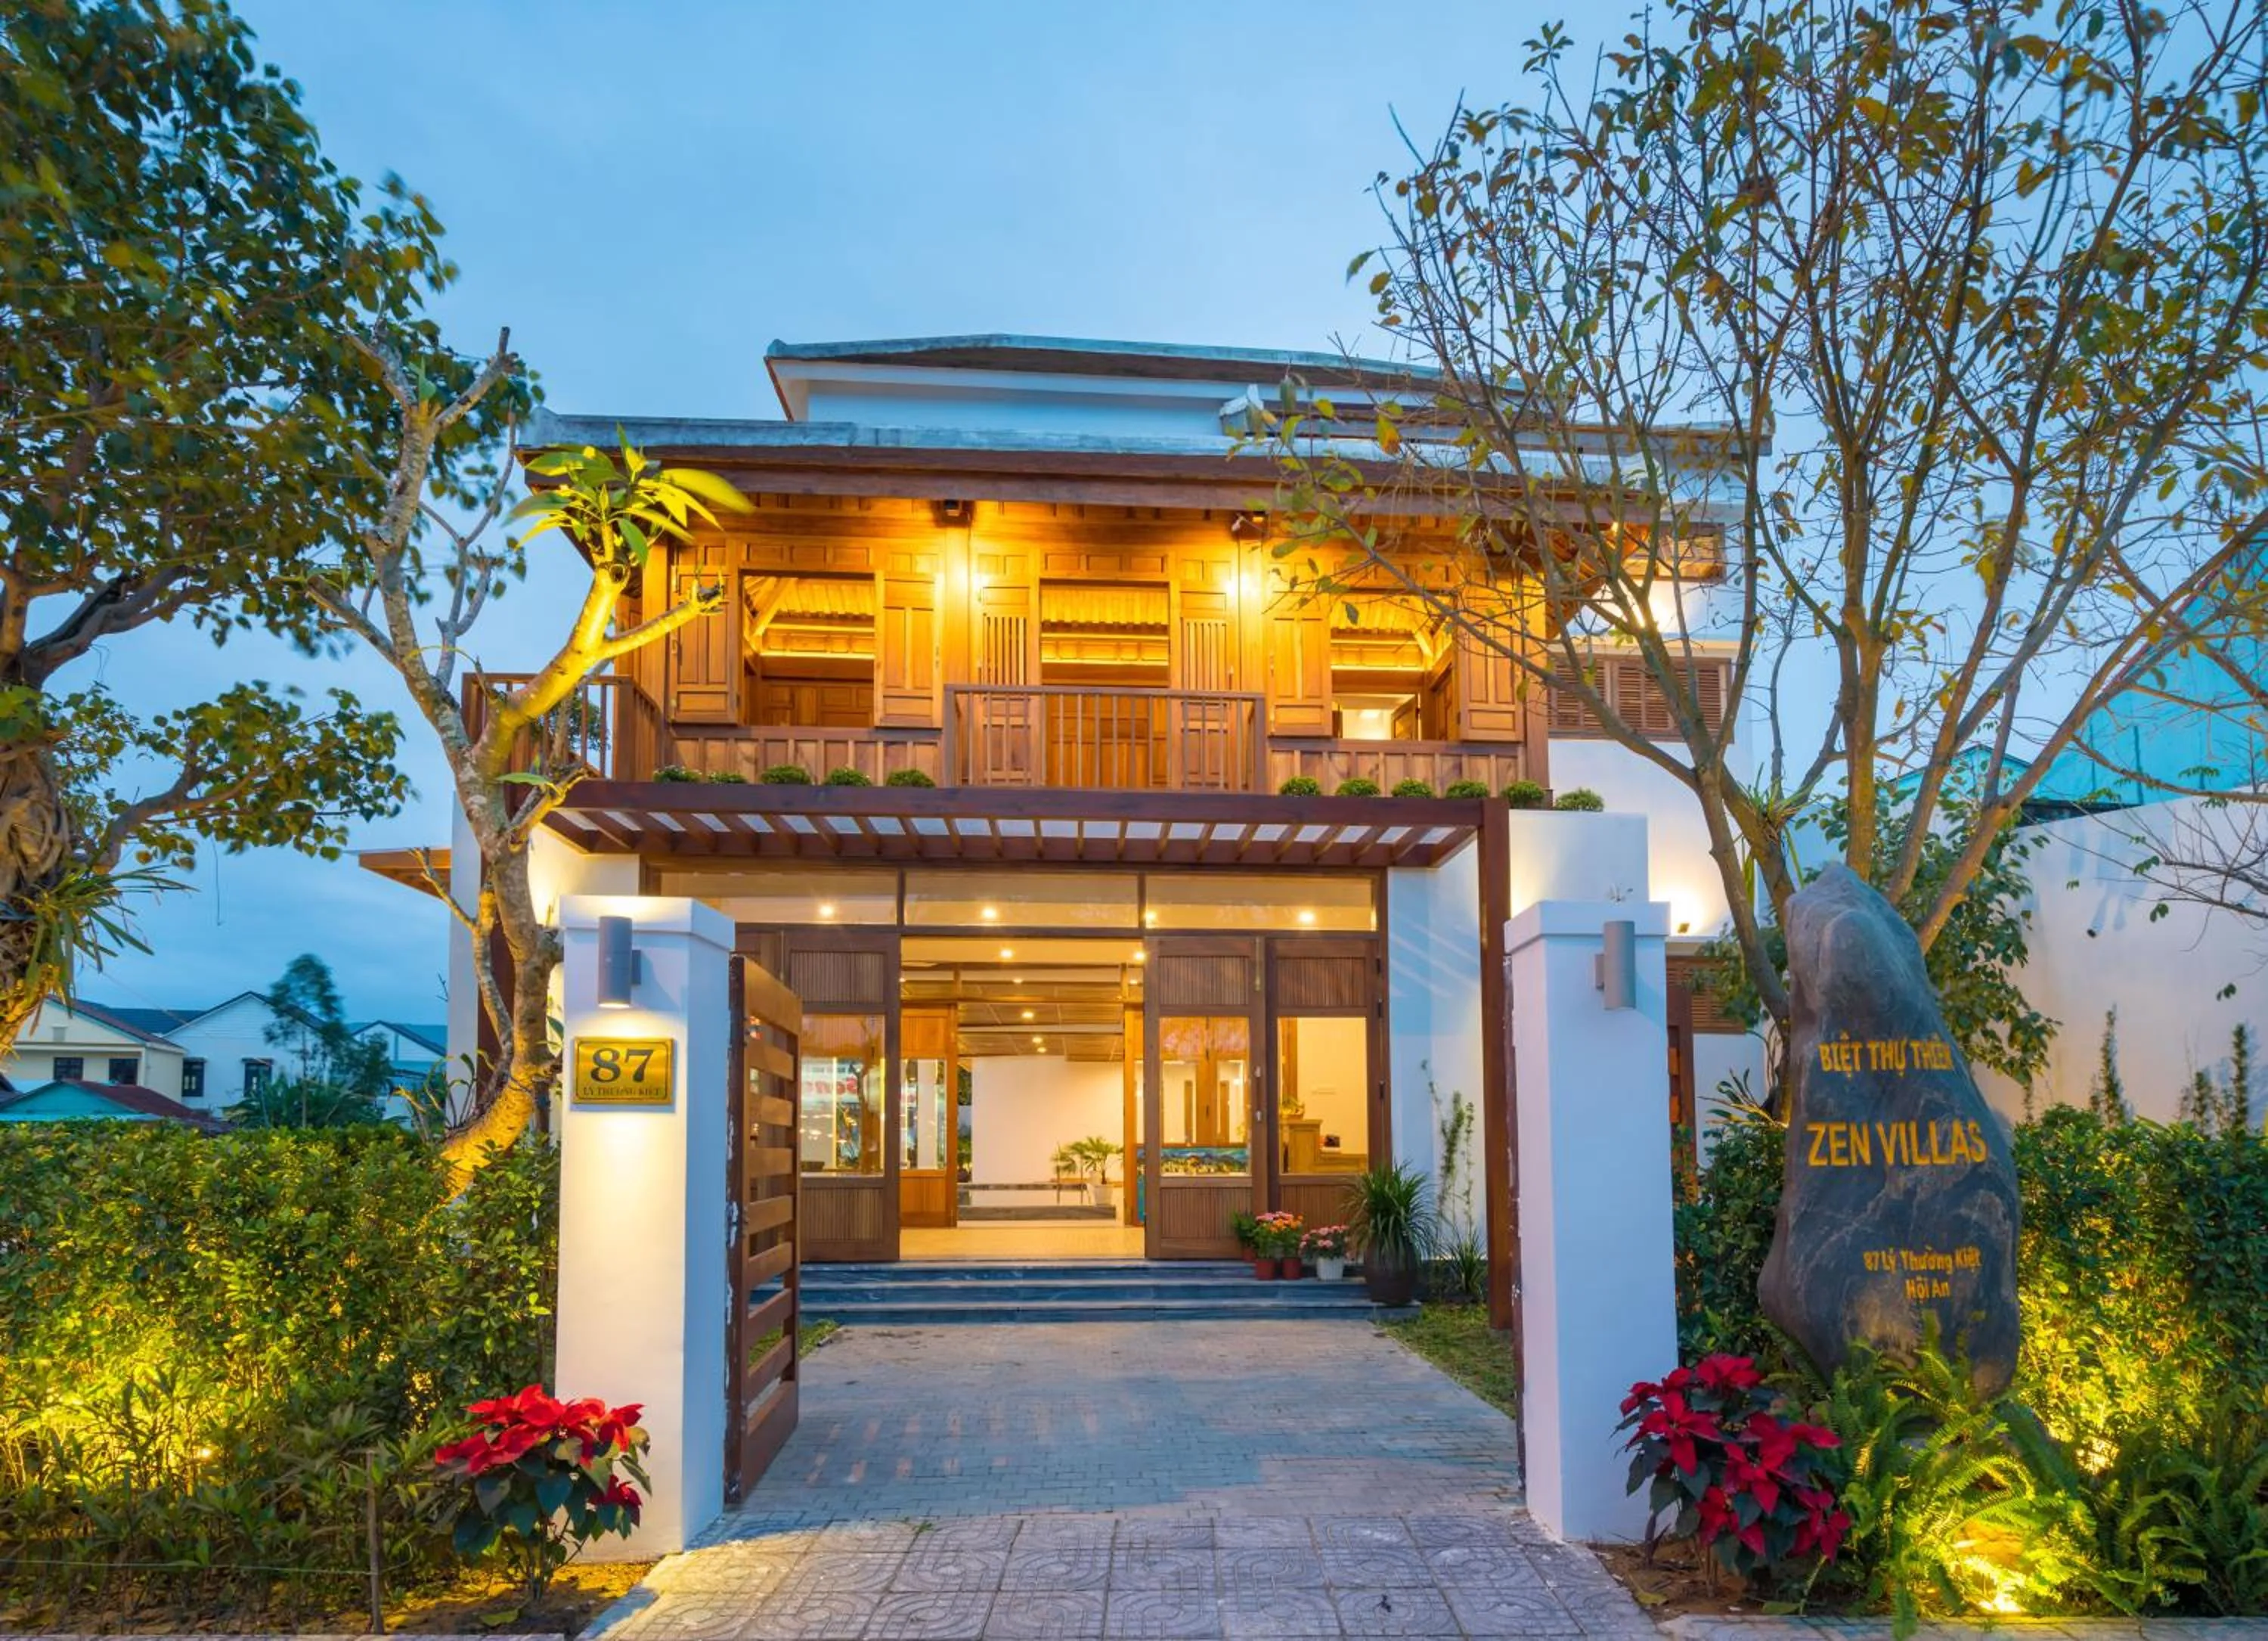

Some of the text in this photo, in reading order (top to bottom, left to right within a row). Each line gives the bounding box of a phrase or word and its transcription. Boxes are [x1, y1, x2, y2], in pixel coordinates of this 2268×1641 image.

[590, 1047, 655, 1083] 87
[1817, 1029, 1863, 1078] BIỆT
[1806, 1118, 1988, 1167] ZEN VILLAS
[1863, 1251, 1879, 1271] 87
[1931, 1278, 1951, 1298] An
